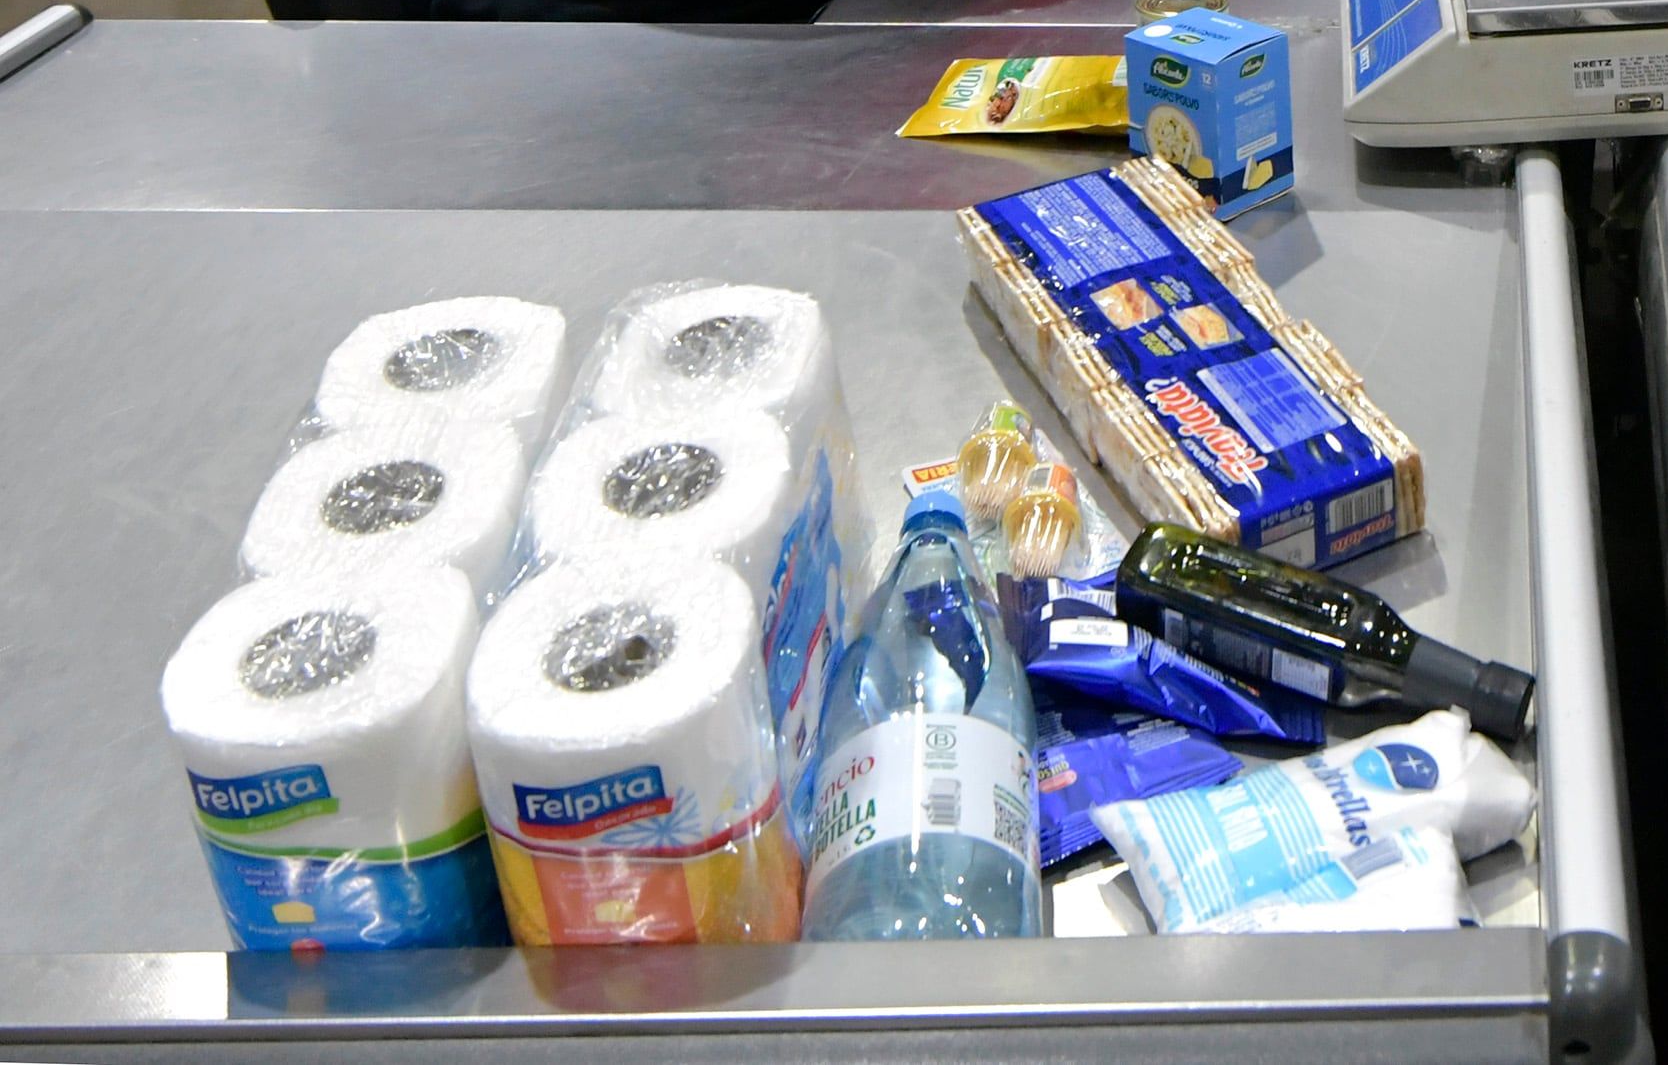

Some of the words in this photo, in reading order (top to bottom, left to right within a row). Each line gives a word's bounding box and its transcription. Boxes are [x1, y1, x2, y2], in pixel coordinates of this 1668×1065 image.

[1573, 59, 1613, 68] KRETZ
[196, 775, 319, 815] Felpita
[525, 776, 654, 821] Felpita
